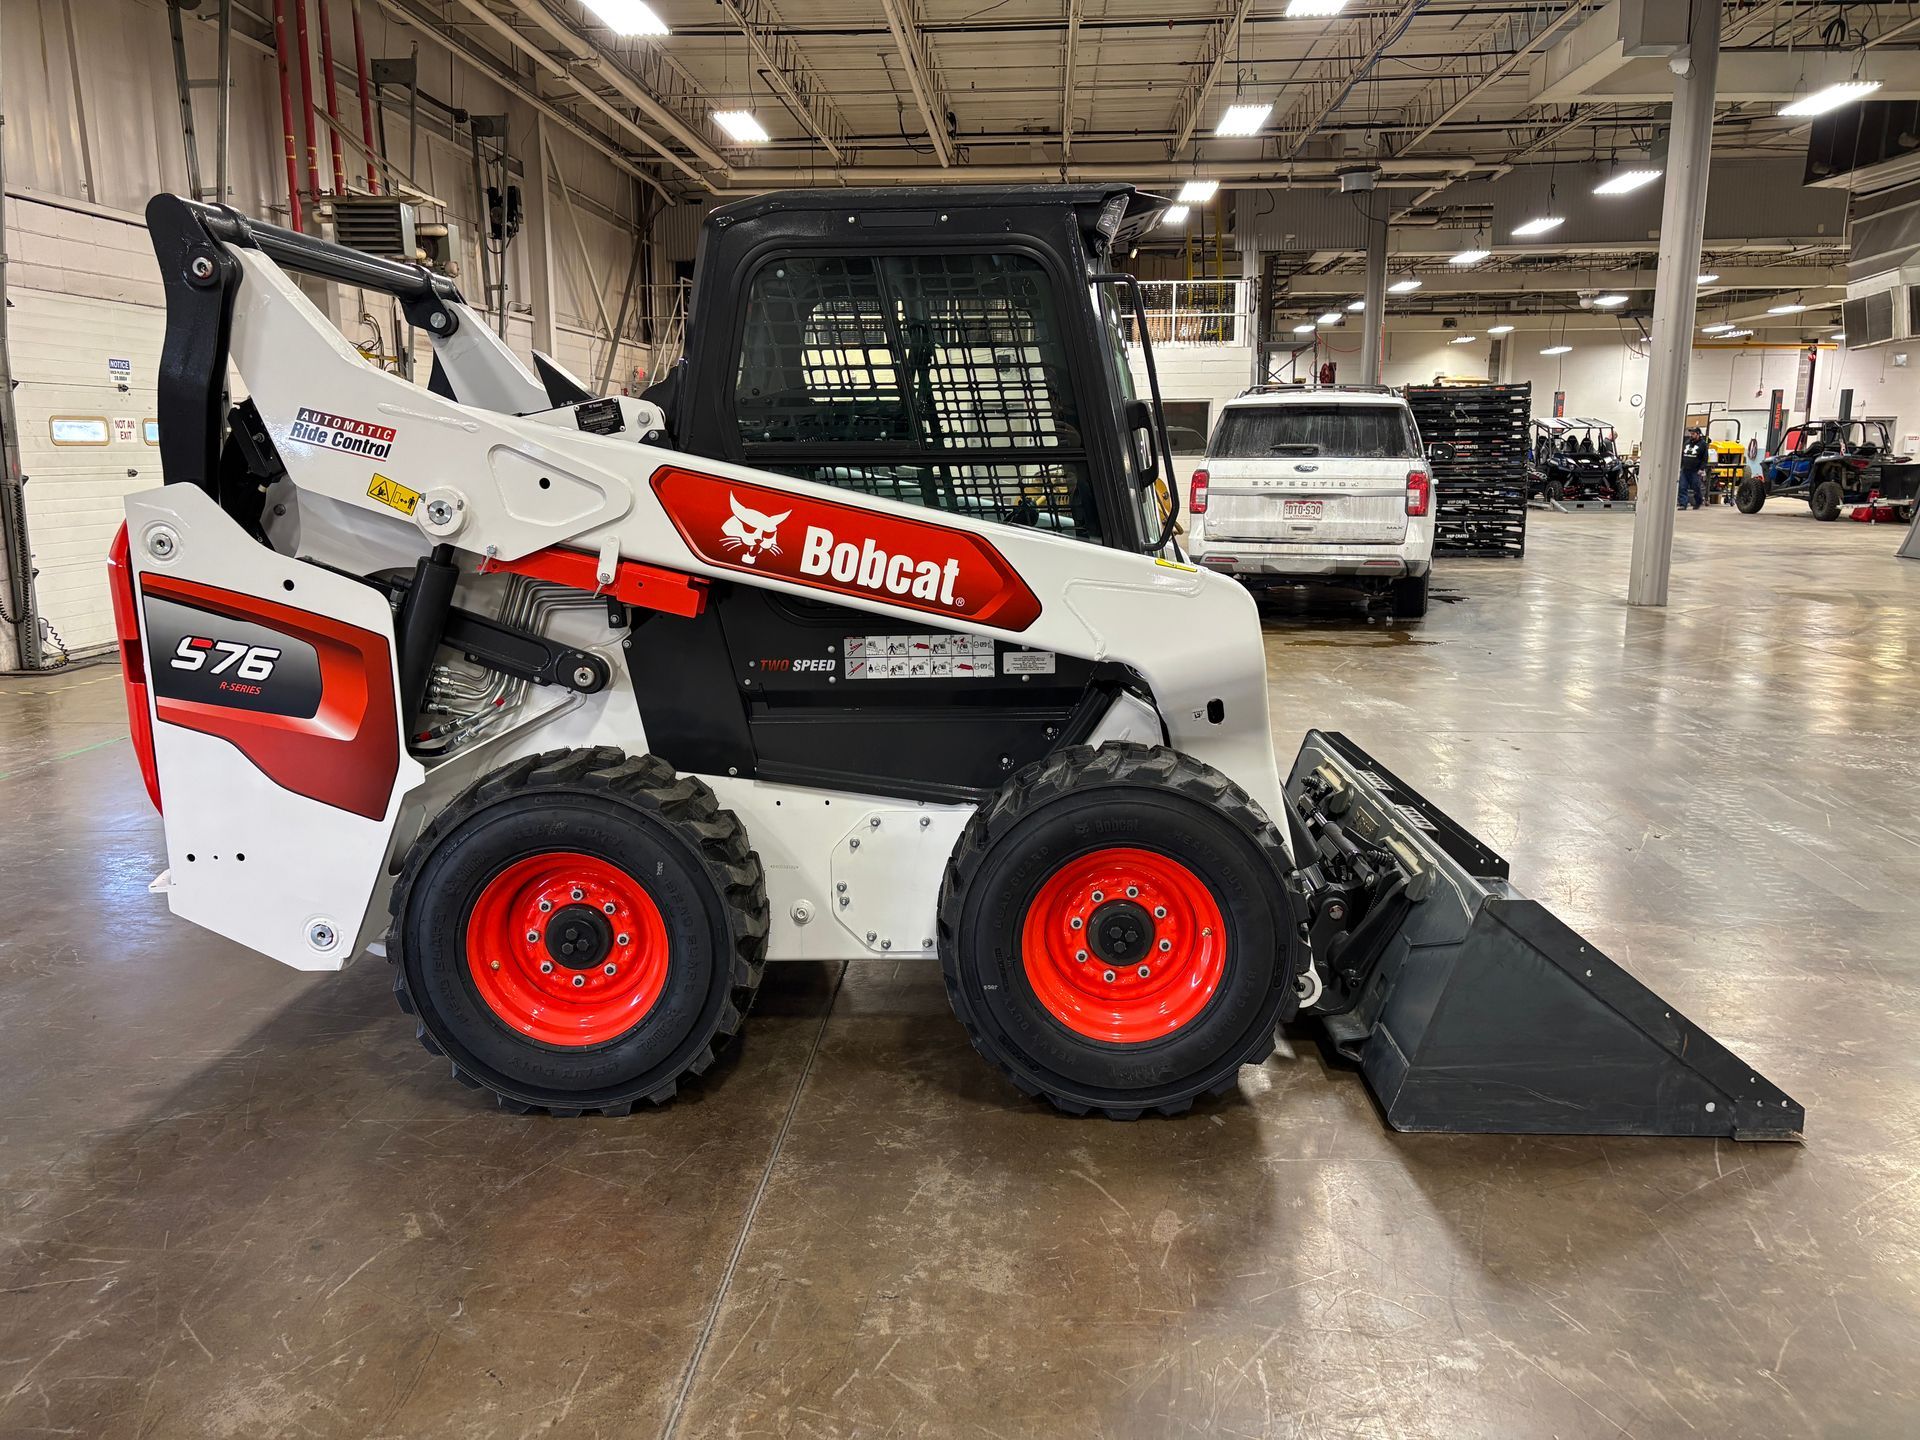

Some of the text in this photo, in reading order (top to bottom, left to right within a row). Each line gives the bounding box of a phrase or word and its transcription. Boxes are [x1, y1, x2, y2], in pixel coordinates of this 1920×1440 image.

[110, 360, 129, 369] NOTICE
[115, 420, 135, 428] NOT AN
[301, 410, 392, 440] AUTOMATIC
[120, 432, 132, 440] EXIT
[290, 422, 392, 458] Ride Control
[800, 526, 960, 606] Bobcat
[171, 636, 282, 680] S76
[760, 660, 835, 672] TWO SPEED
[220, 681, 262, 695] R-SERIES
[1096, 818, 1140, 834] Bobcat
[1174, 831, 1249, 902] HEAVY DUTY
